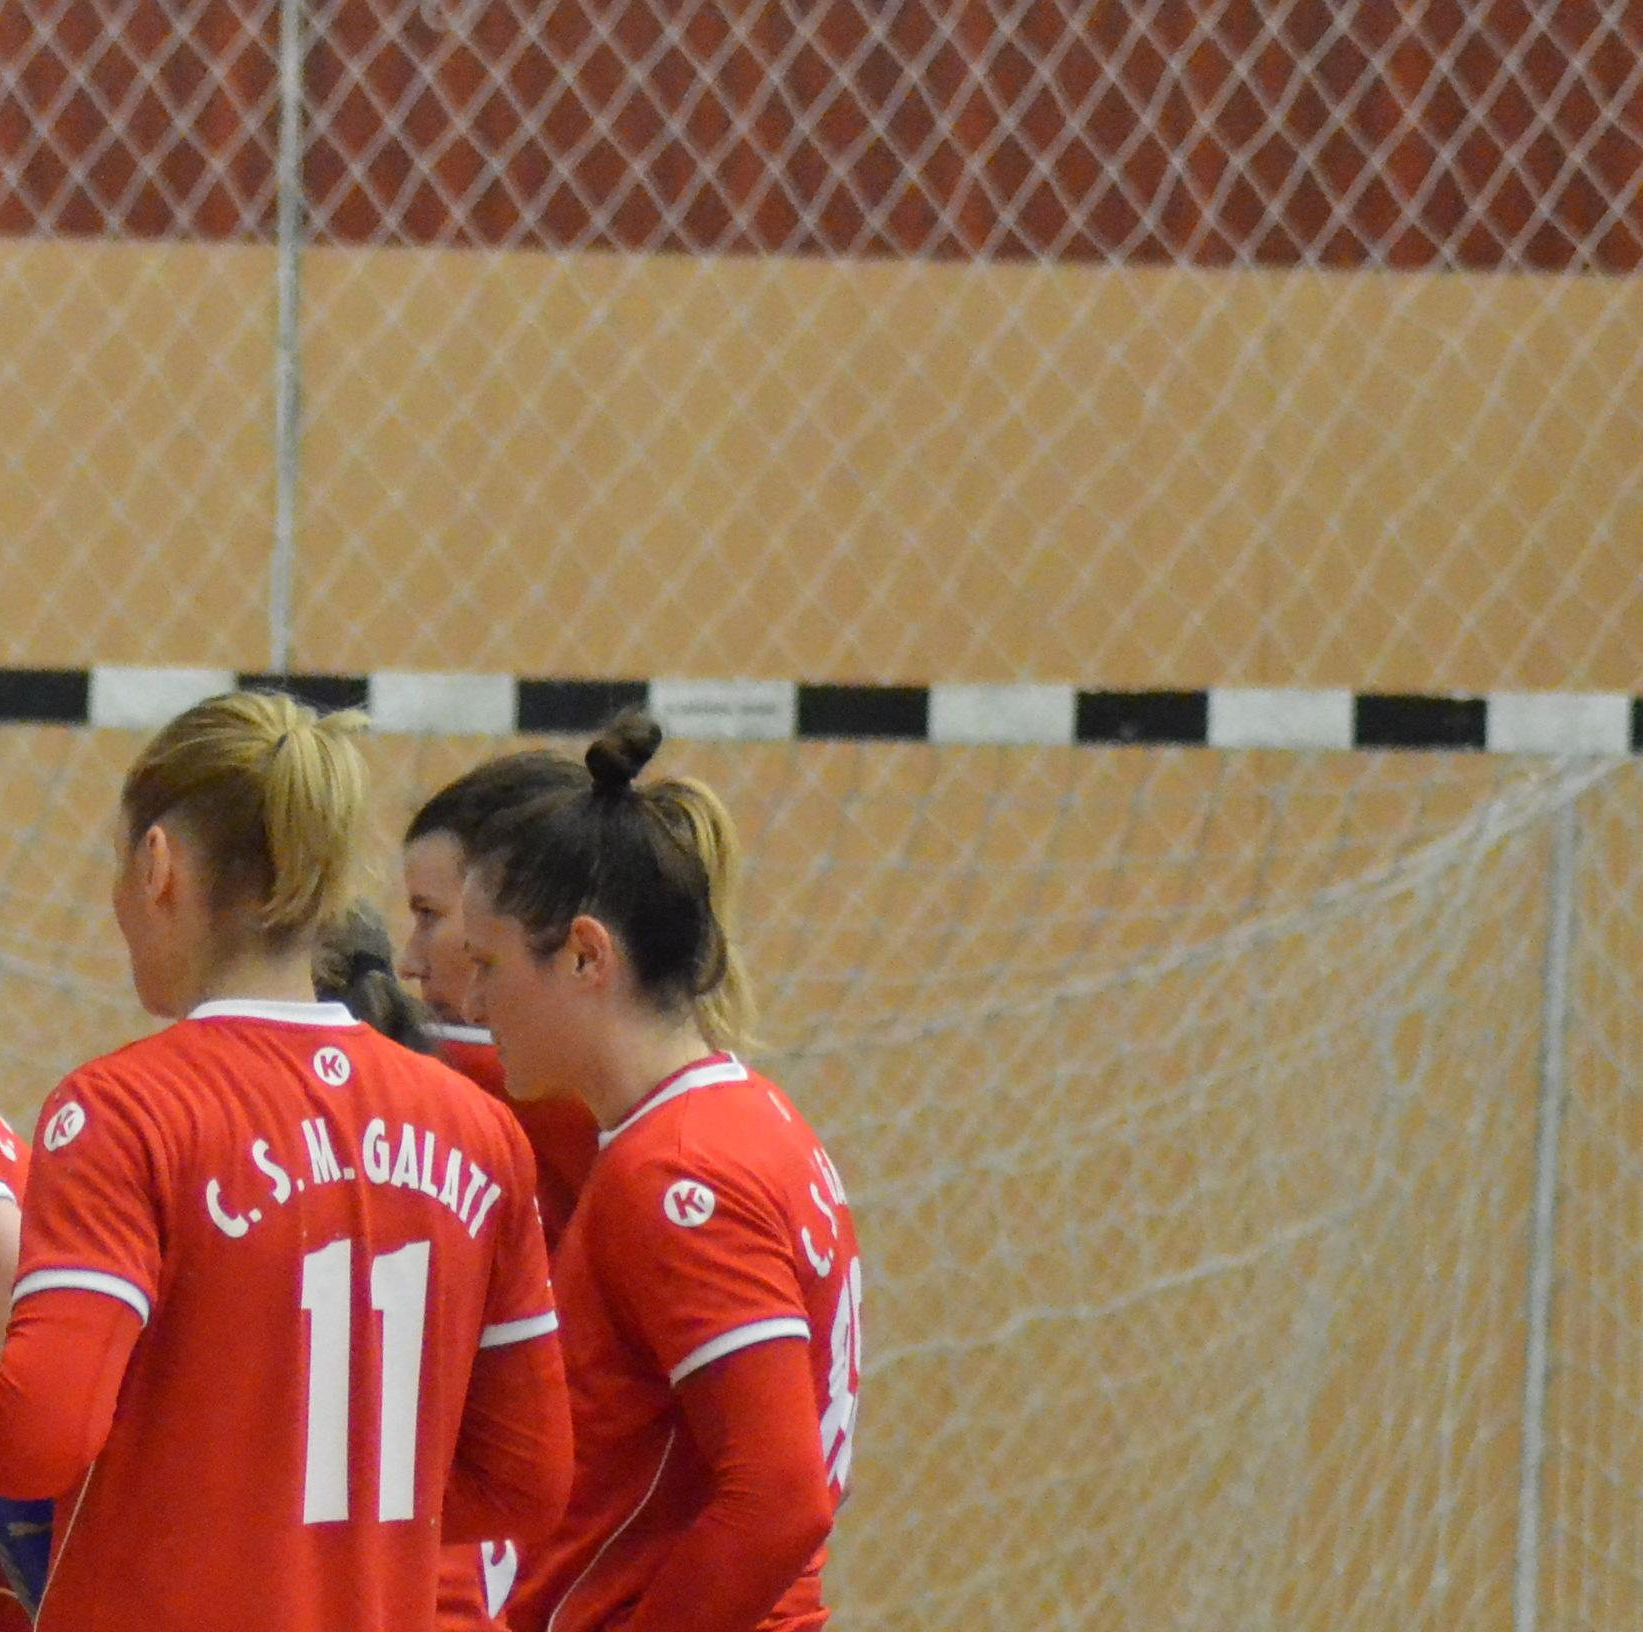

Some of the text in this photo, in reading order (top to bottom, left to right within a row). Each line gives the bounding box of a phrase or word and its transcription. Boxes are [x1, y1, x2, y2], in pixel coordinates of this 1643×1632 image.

[205, 1115, 503, 1241] C. S. M. GALATI
[299, 1236, 432, 1526] 11
